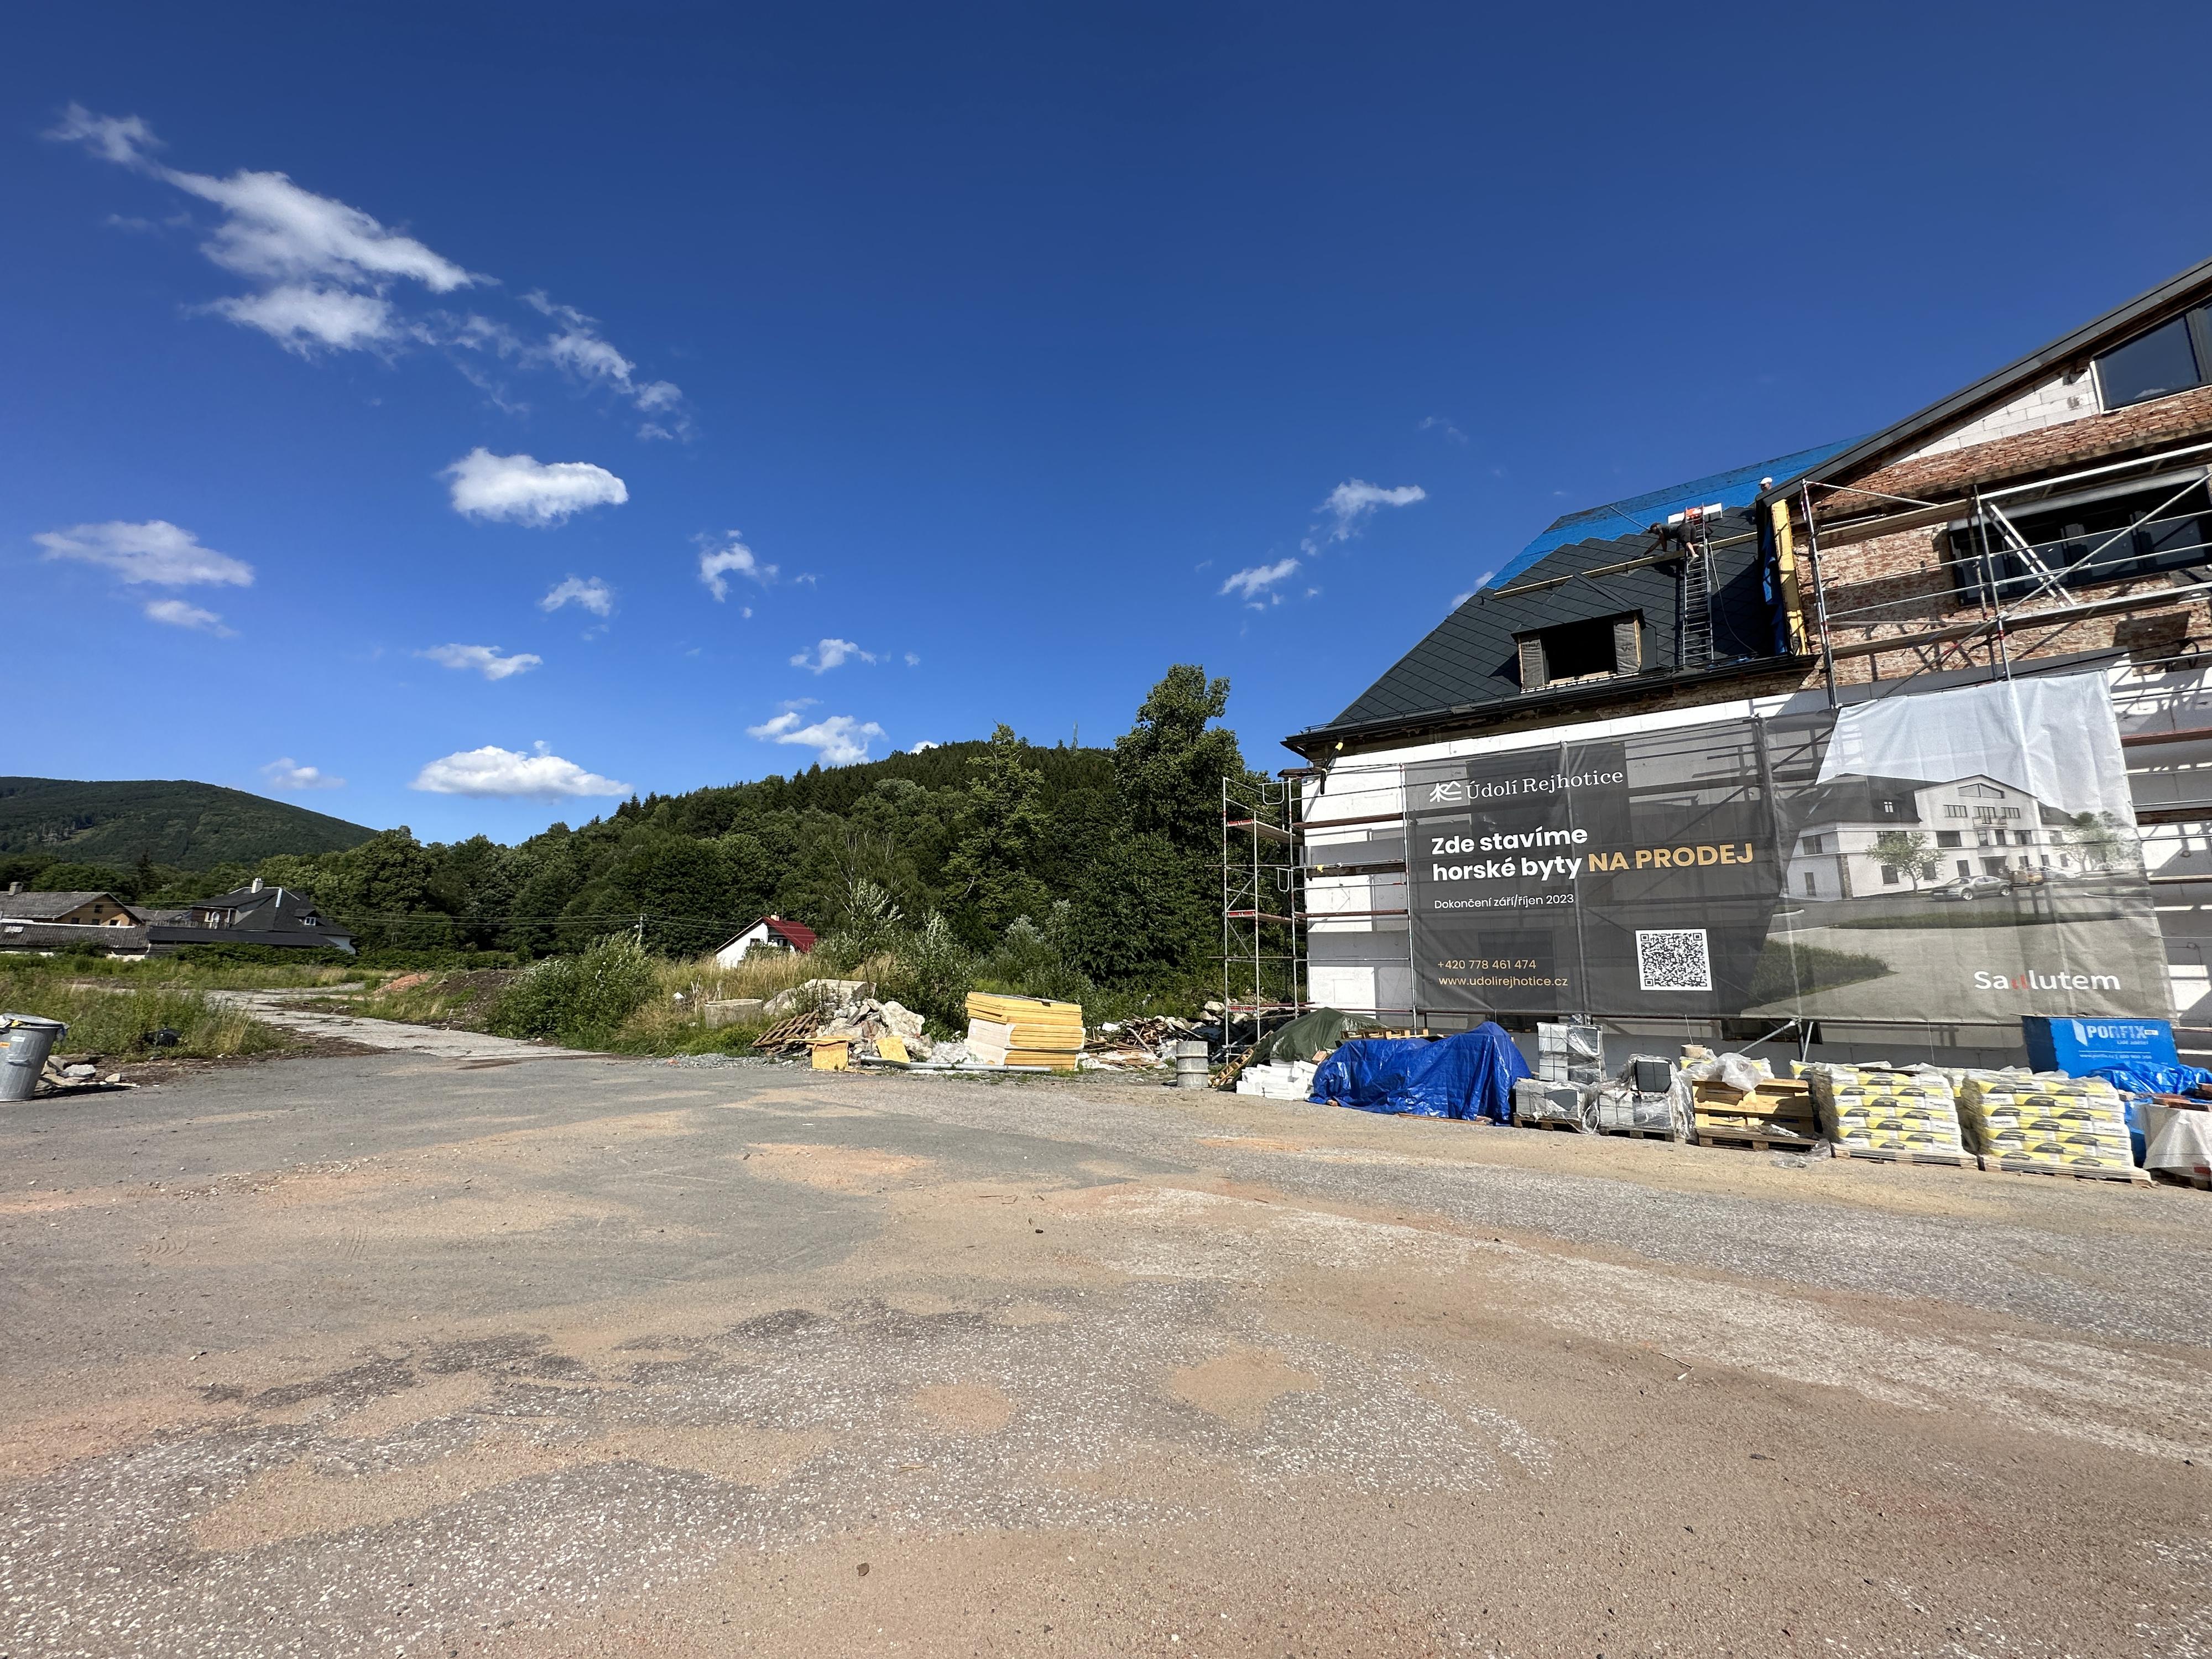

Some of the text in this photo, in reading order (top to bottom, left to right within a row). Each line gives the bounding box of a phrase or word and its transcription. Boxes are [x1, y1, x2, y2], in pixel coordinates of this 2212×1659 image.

[1465, 770, 1624, 800] Údolí Rejhotice
[1431, 826, 1588, 855] Zde stavíme
[1432, 843, 1754, 881] horské byty NA PRODEJ
[1434, 894, 1574, 909] Dokončení září/říjen 2023
[1438, 959, 1536, 969] +420 778 461 474
[1438, 976, 1568, 989] www.udolirejhotice.cz
[2086, 1025, 2147, 1039] PORFIX
